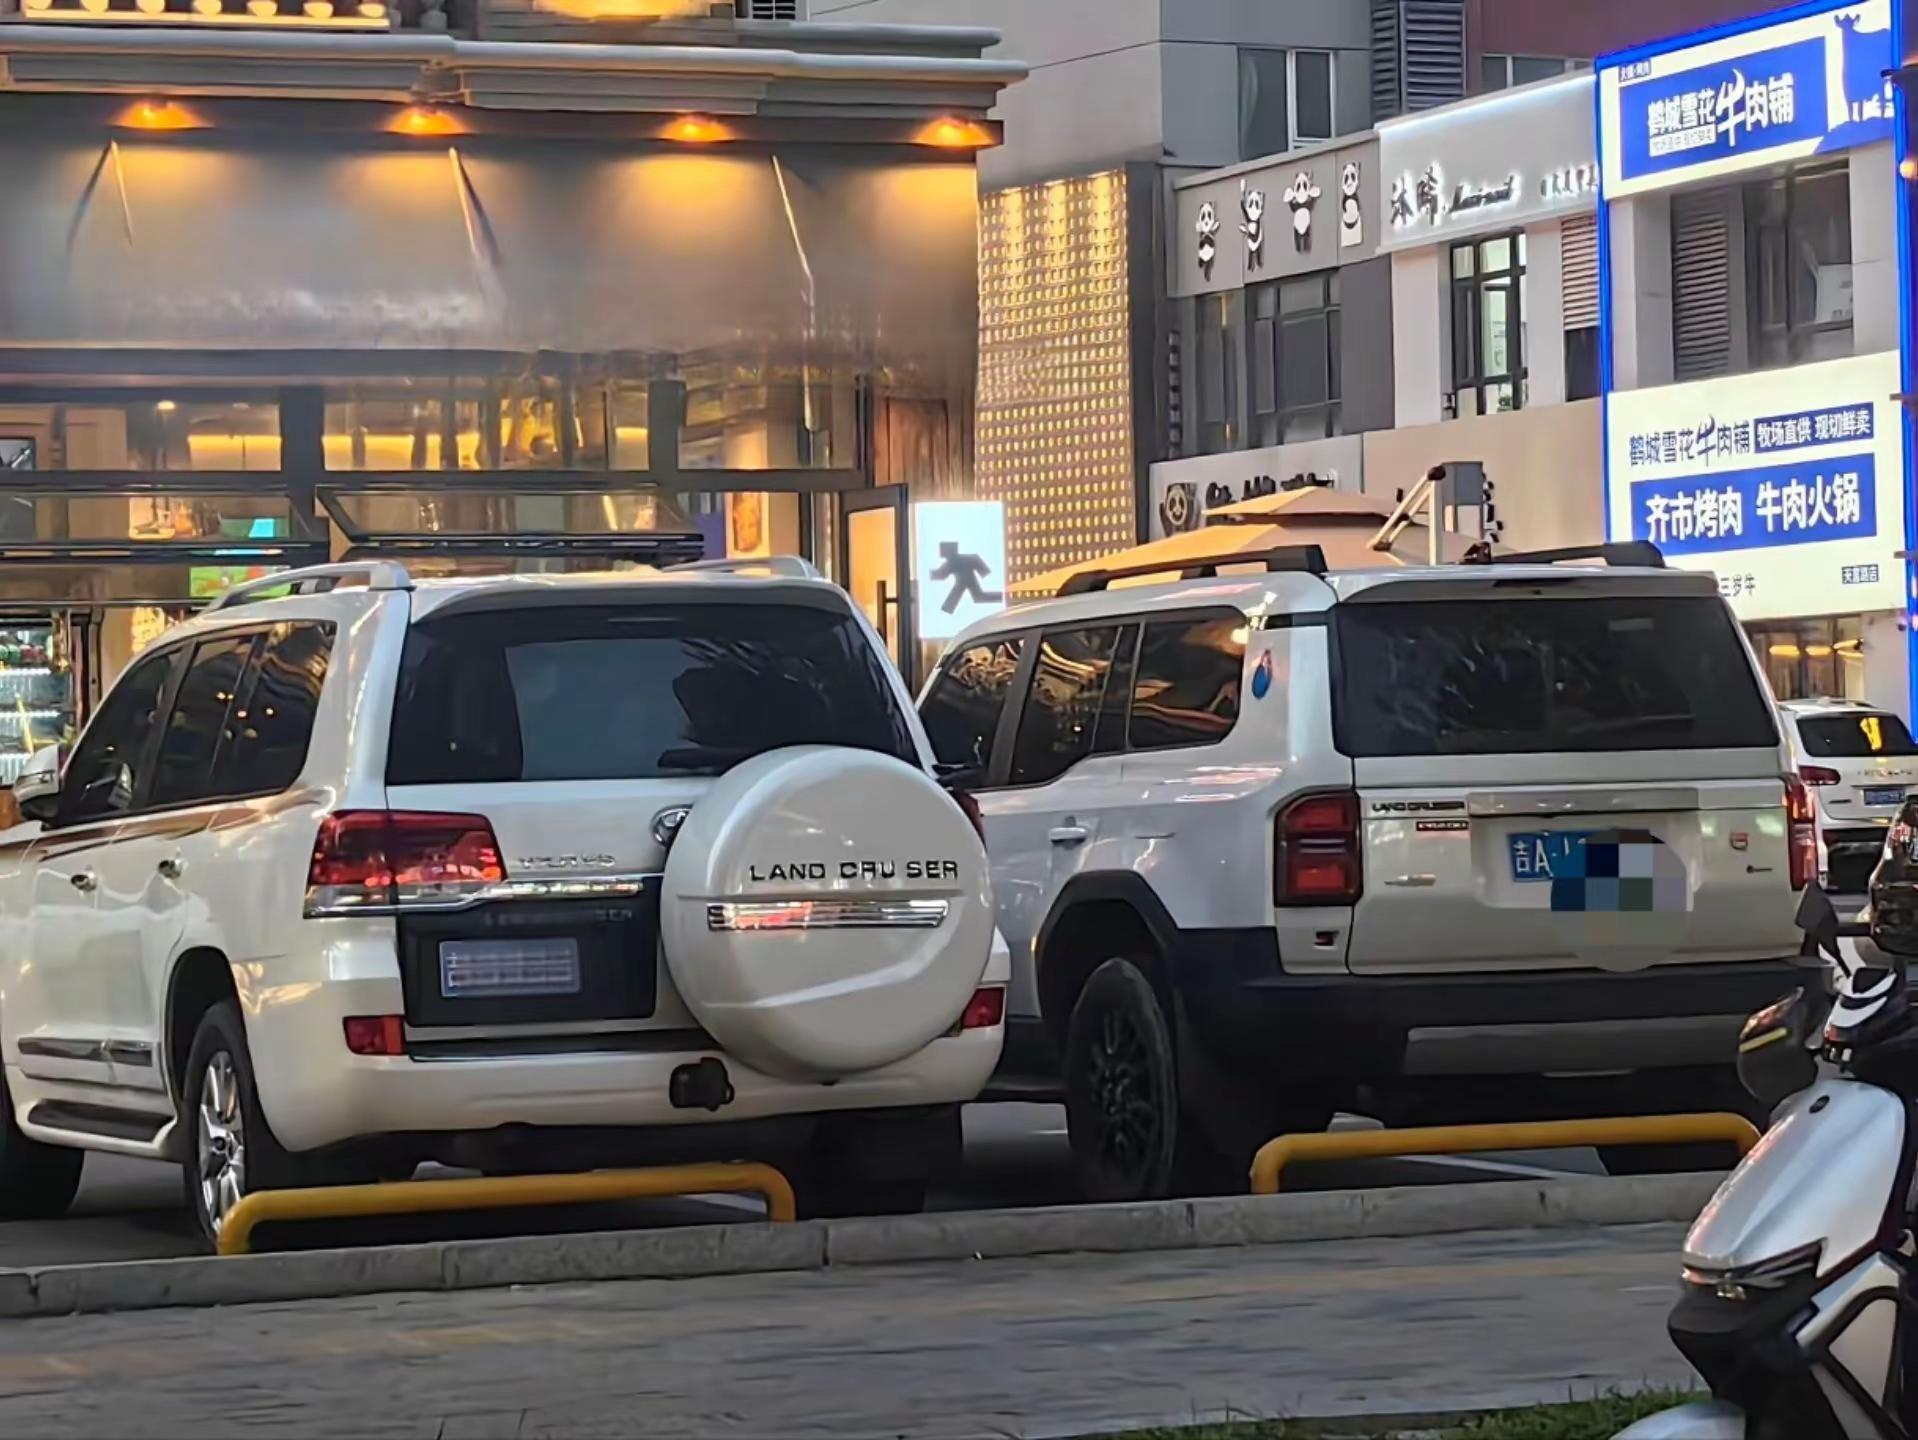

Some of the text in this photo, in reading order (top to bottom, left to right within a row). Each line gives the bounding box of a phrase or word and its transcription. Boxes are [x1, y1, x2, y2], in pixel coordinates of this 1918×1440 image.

[1757, 407, 1871, 448] 牧场直供 现切鲜卖
[1645, 471, 1861, 544] 齐市烤肉 牛肉火锅
[750, 864, 826, 881] LAND
